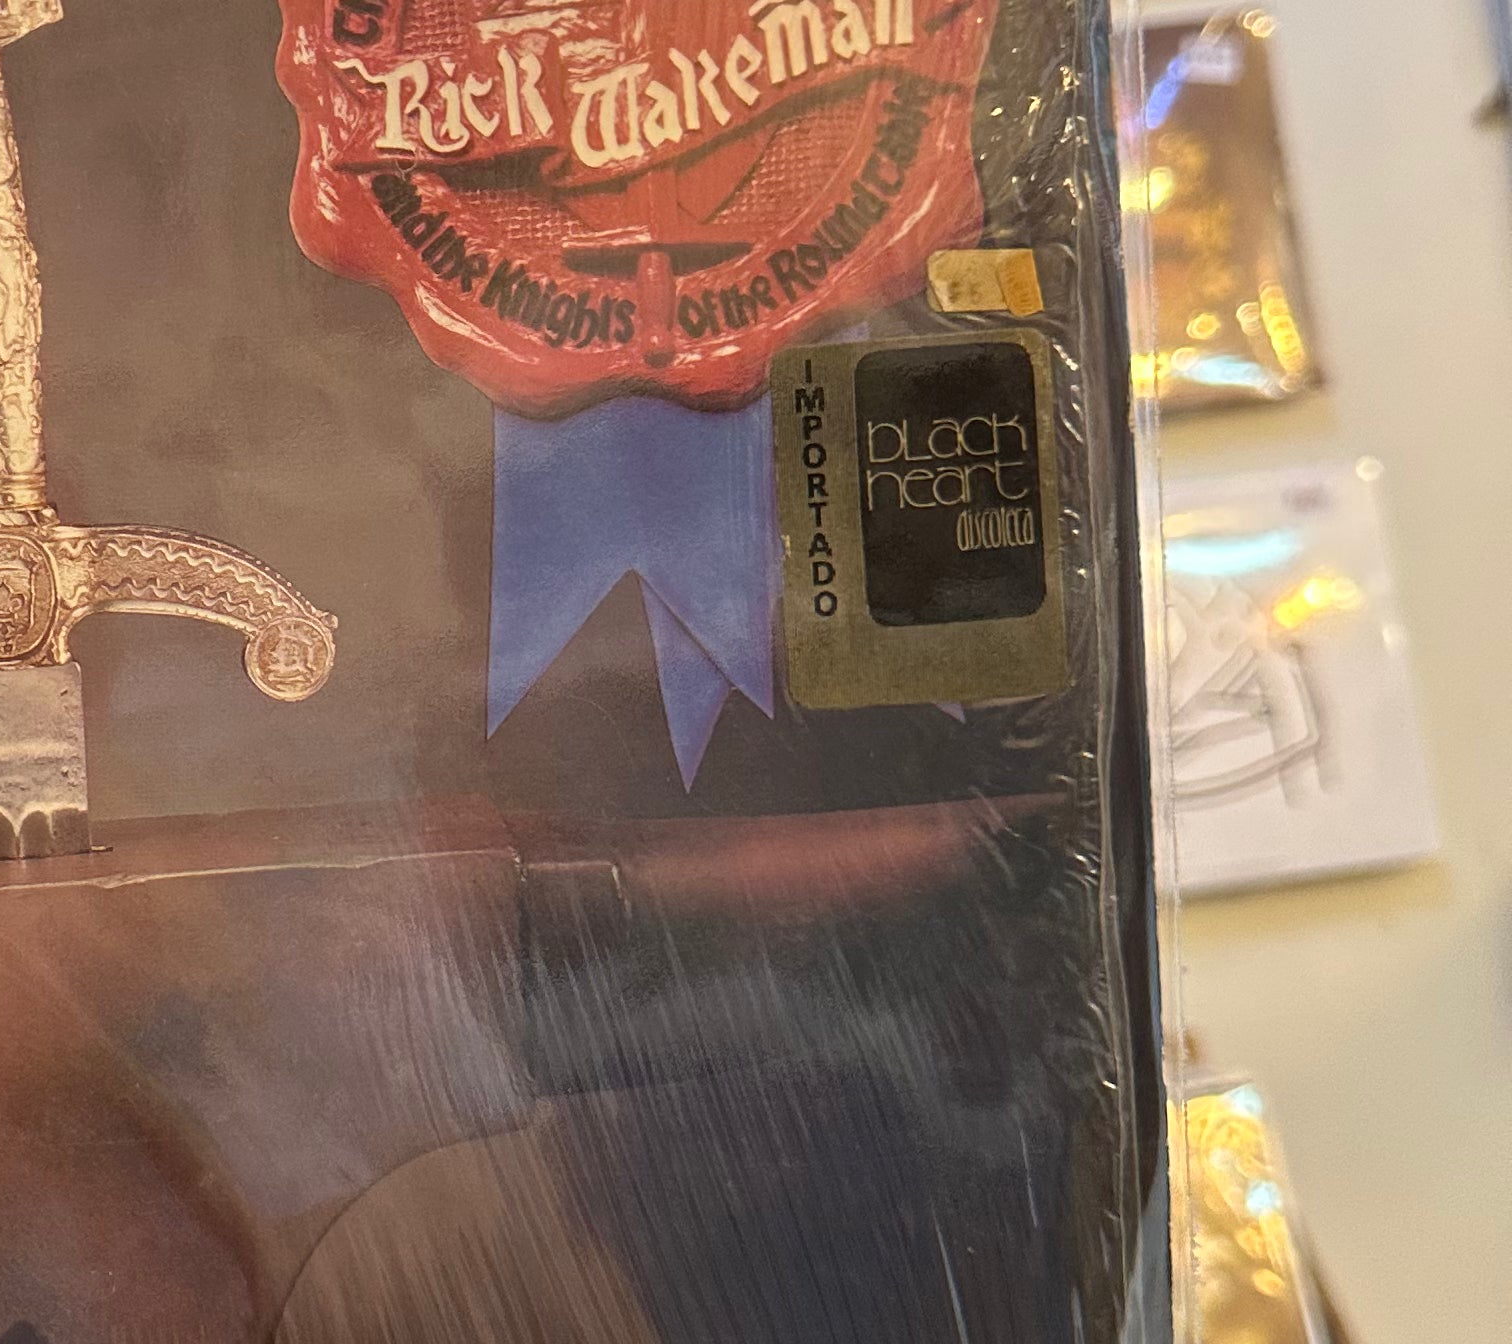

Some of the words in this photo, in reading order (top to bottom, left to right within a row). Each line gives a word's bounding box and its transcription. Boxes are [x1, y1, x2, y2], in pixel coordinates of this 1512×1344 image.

[334, 44, 555, 154] Rick
[370, 172, 450, 250] and
[420, 225, 489, 293] the
[479, 257, 638, 350] Knights
[718, 274, 778, 329] the
[765, 179, 891, 305] Round
[793, 359, 838, 617] IMPORTADO
